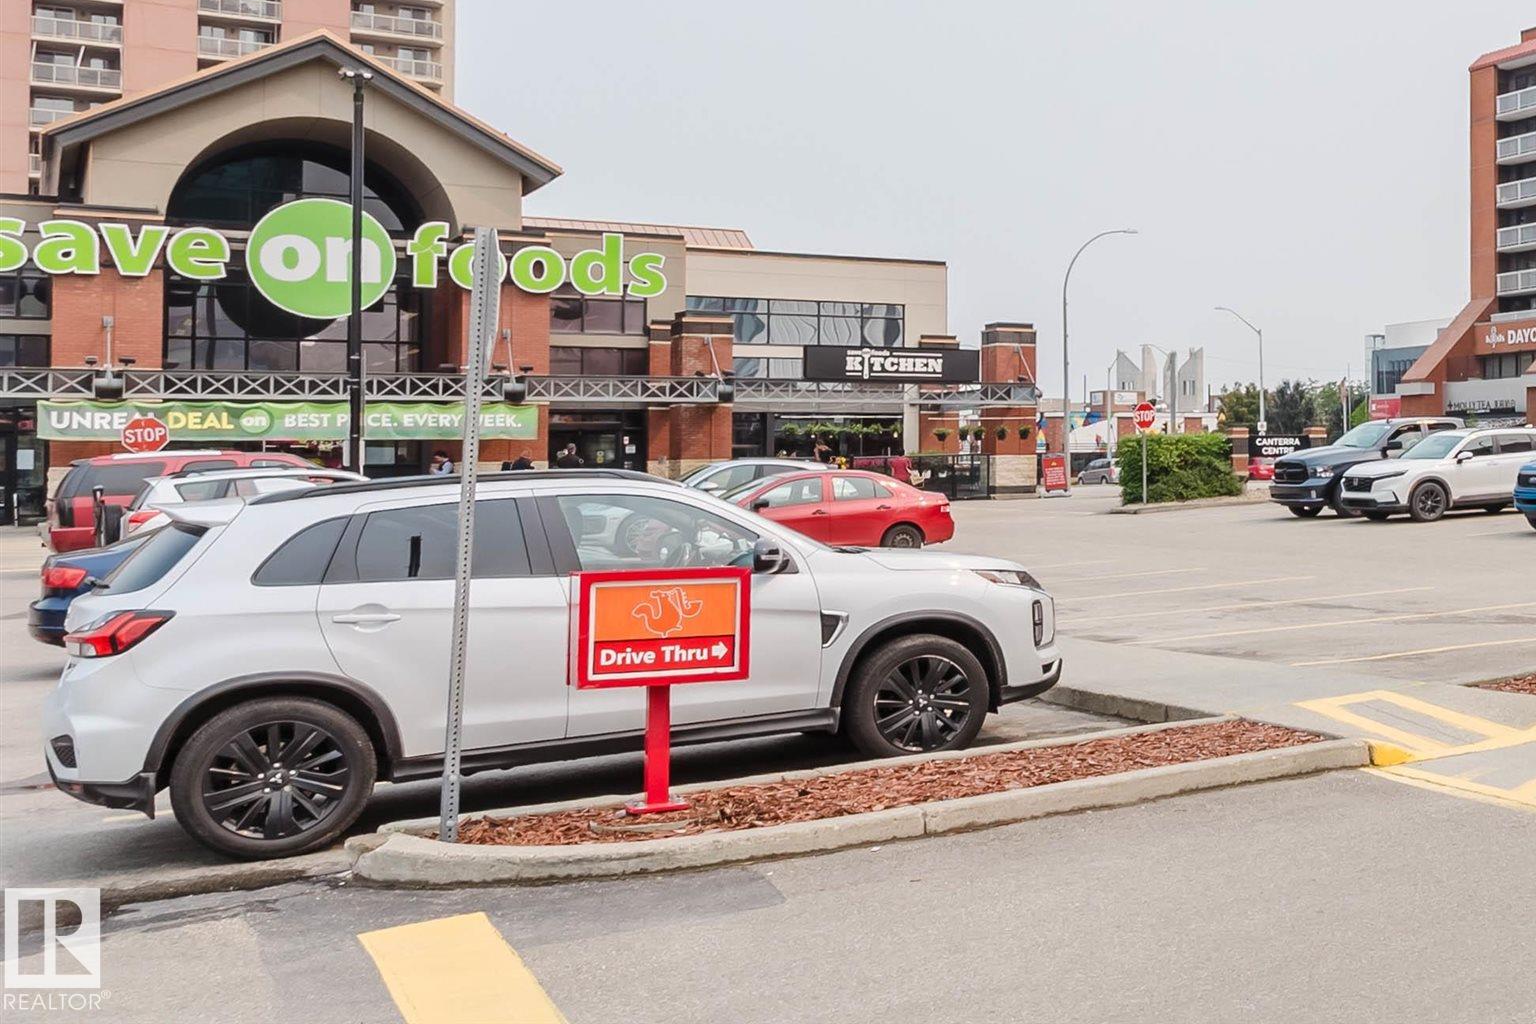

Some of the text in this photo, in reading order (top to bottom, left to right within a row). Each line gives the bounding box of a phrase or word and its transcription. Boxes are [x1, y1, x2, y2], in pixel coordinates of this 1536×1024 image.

[260, 233, 382, 283] on
[406, 221, 667, 297] foods
[846, 355, 943, 377] KITCHEN
[167, 411, 235, 429] DEAL
[240, 415, 268, 427] on
[284, 413, 330, 428] BEST
[403, 413, 460, 428] EVERY
[478, 414, 522, 428] EEK.
[1134, 410, 1155, 422] STOP
[125, 427, 165, 443] STOP
[1255, 437, 1300, 446] CANTERRA
[1262, 446, 1295, 456] CENTRE
[600, 645, 708, 666] Drive Thru
